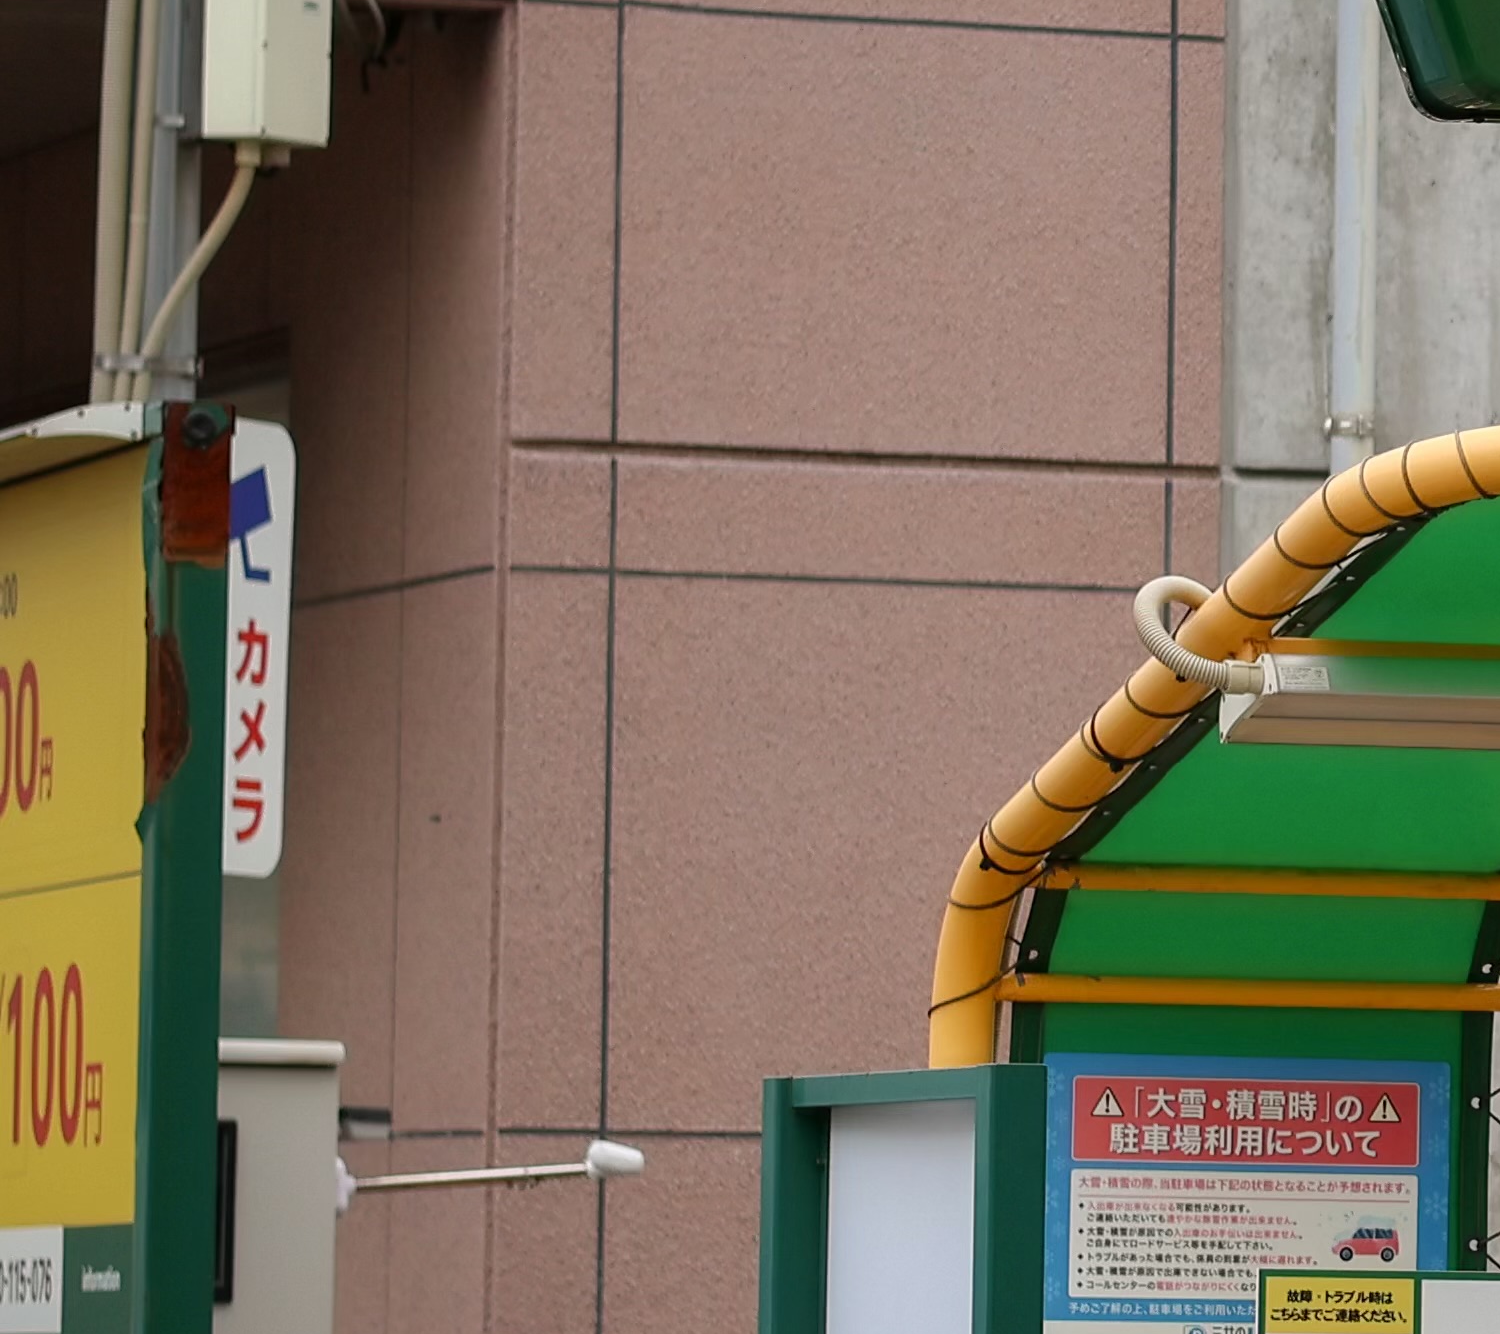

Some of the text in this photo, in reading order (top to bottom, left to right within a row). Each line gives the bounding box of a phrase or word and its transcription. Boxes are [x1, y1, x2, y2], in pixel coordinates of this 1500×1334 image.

[231, 618, 269, 844] カメラ
[1134, 1085, 1363, 1123] 「大雪・積雪時」の
[1109, 1122, 1381, 1157] 駐車場利用について
[1270, 1308, 1407, 1323] こちらまでご連絡ください。
